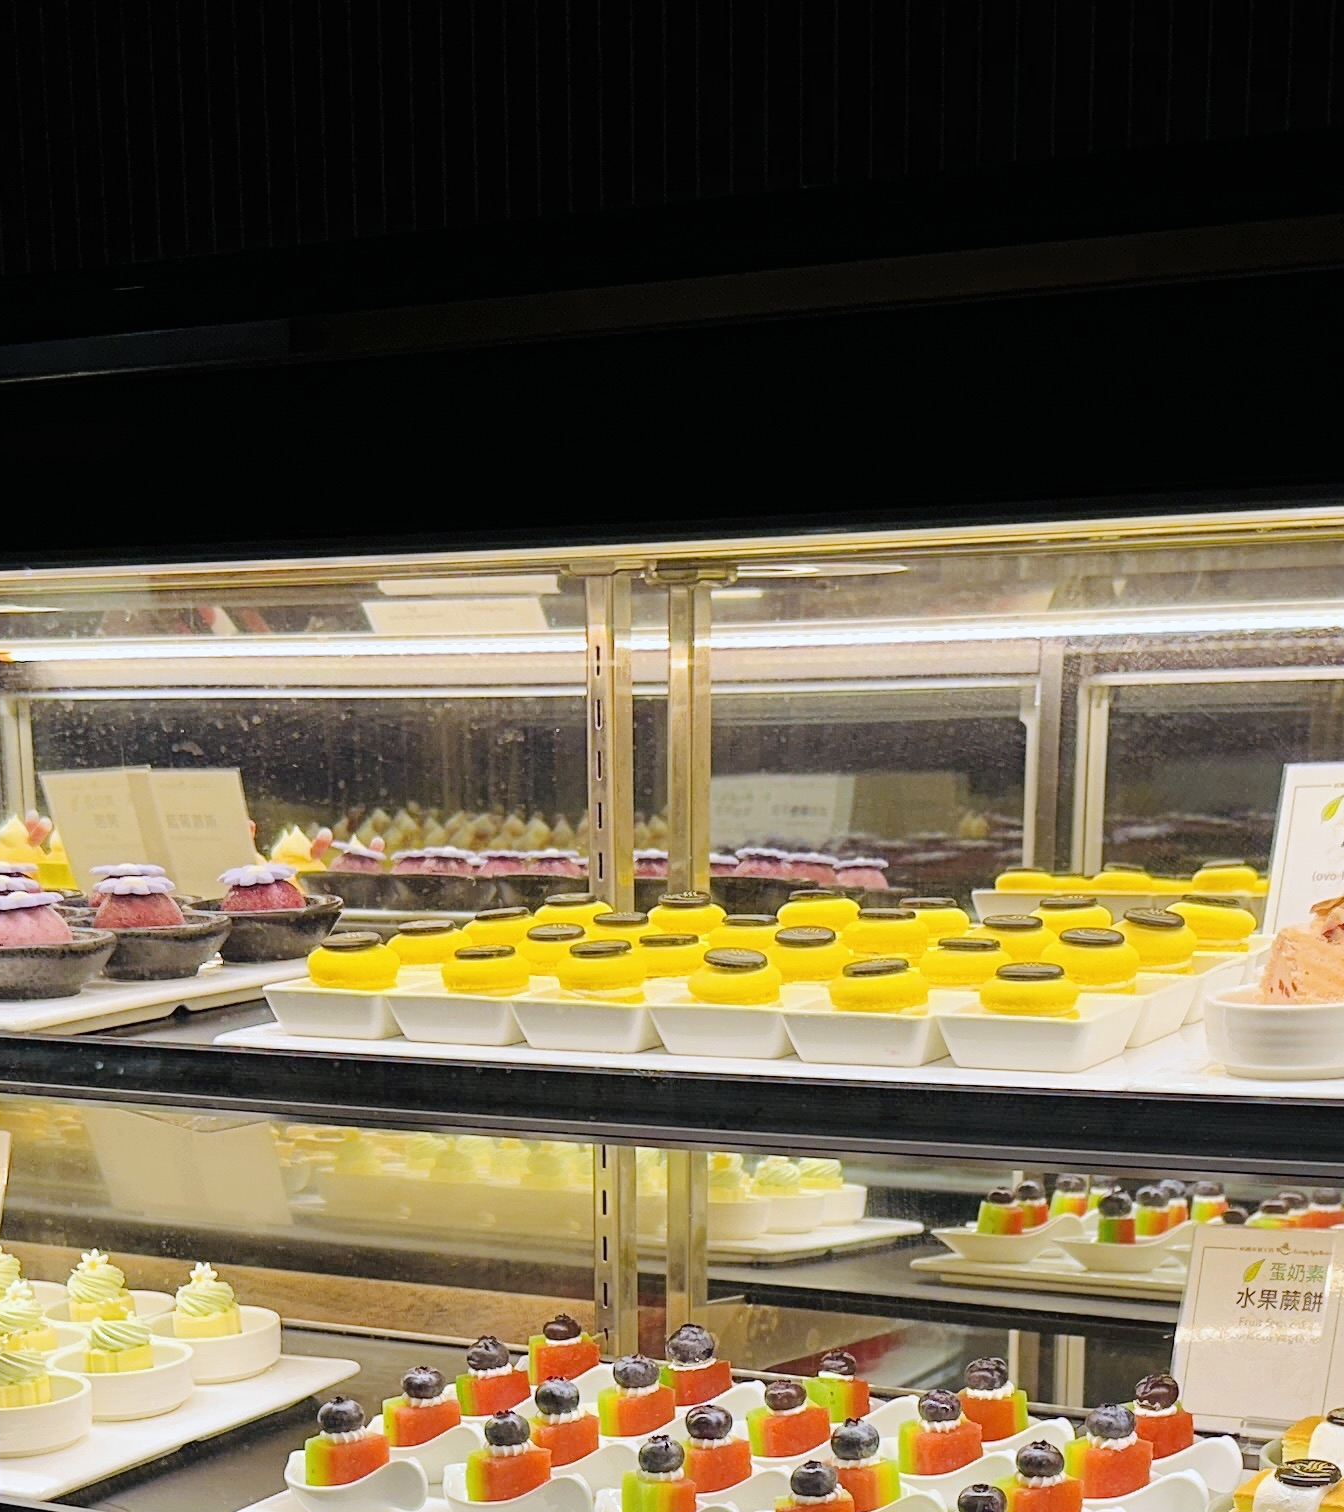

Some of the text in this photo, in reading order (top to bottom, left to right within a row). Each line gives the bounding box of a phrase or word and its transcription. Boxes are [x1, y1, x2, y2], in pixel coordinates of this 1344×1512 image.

[1269, 1262, 1323, 1284] 蛋奶素
[1235, 1287, 1323, 1313] 水果蕨餅
